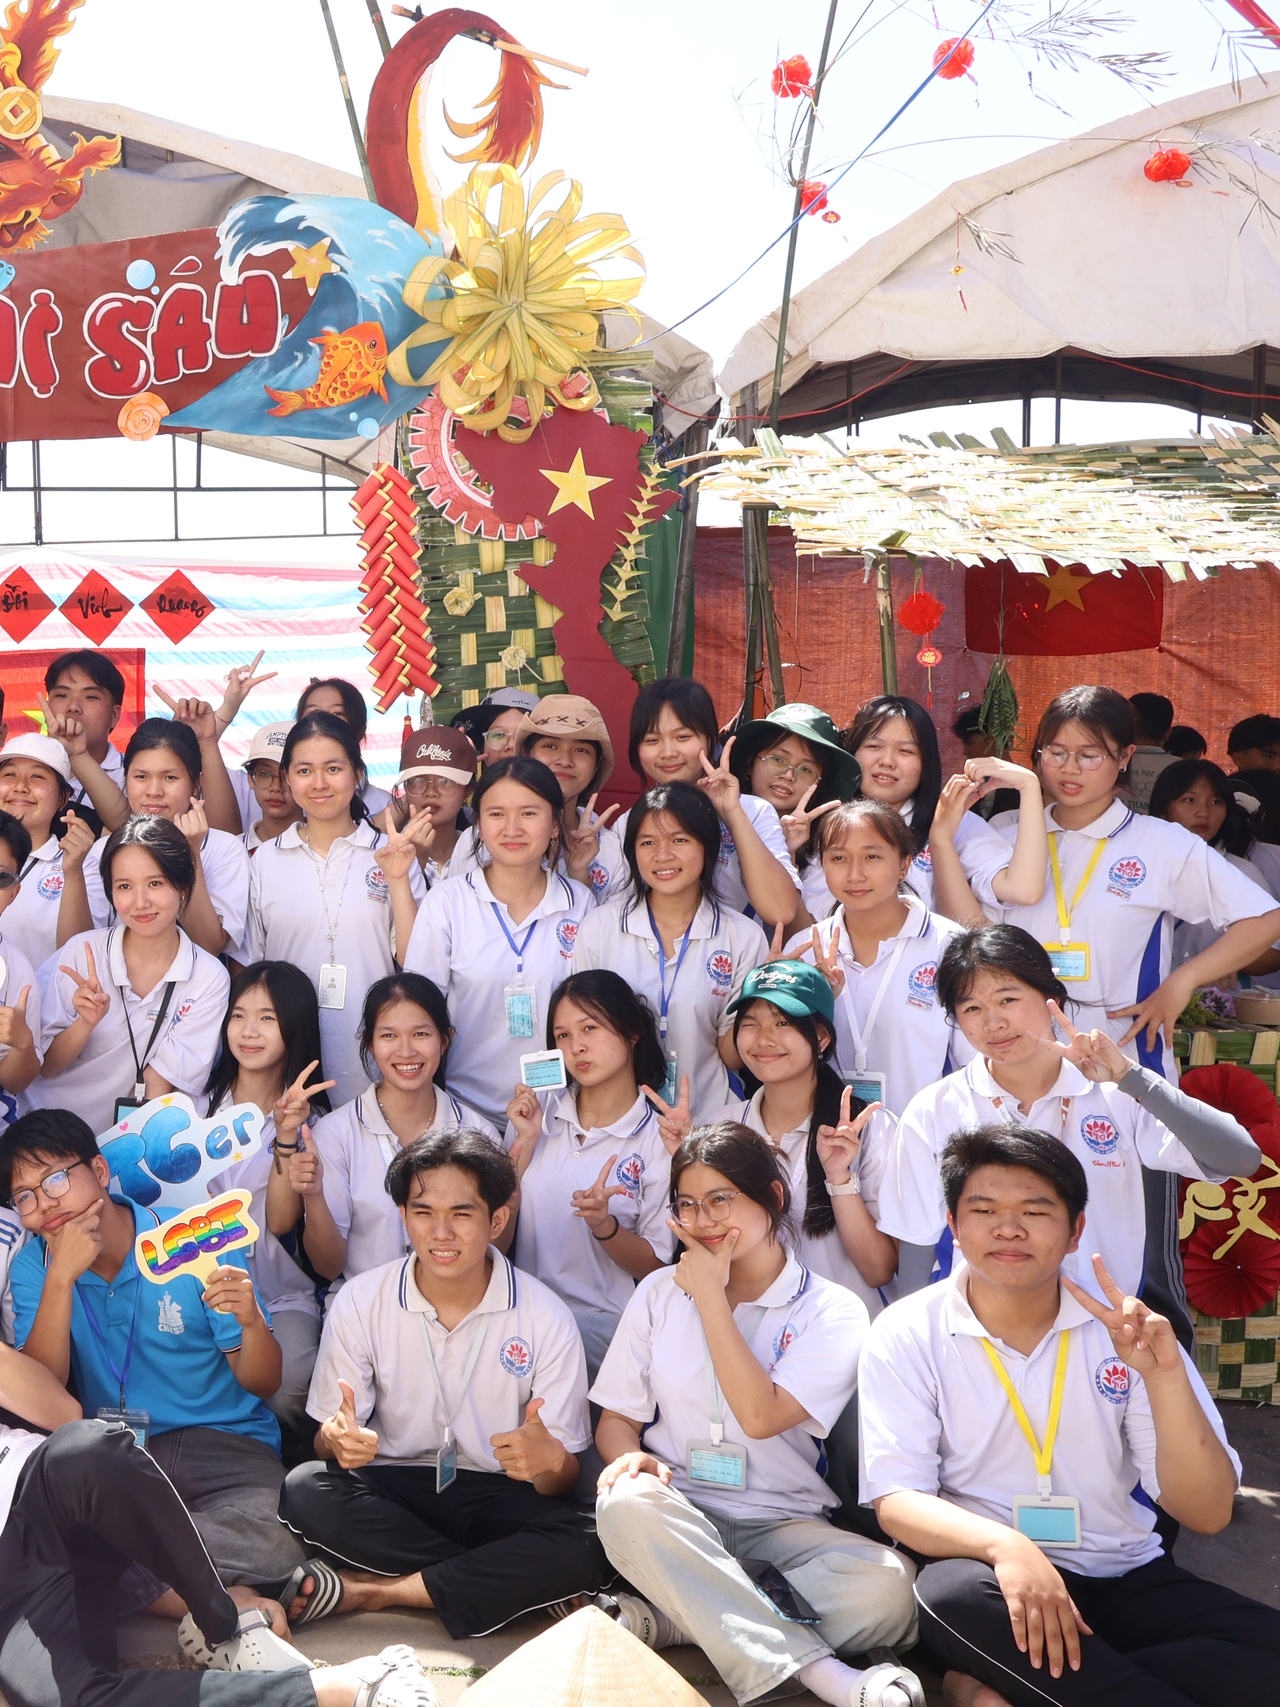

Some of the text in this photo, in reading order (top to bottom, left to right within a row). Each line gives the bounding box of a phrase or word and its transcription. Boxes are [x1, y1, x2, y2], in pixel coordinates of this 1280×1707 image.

[84, 255, 283, 399] SÁU
[749, 970, 798, 984] Dodgers
[141, 1199, 248, 1276] LGBT
